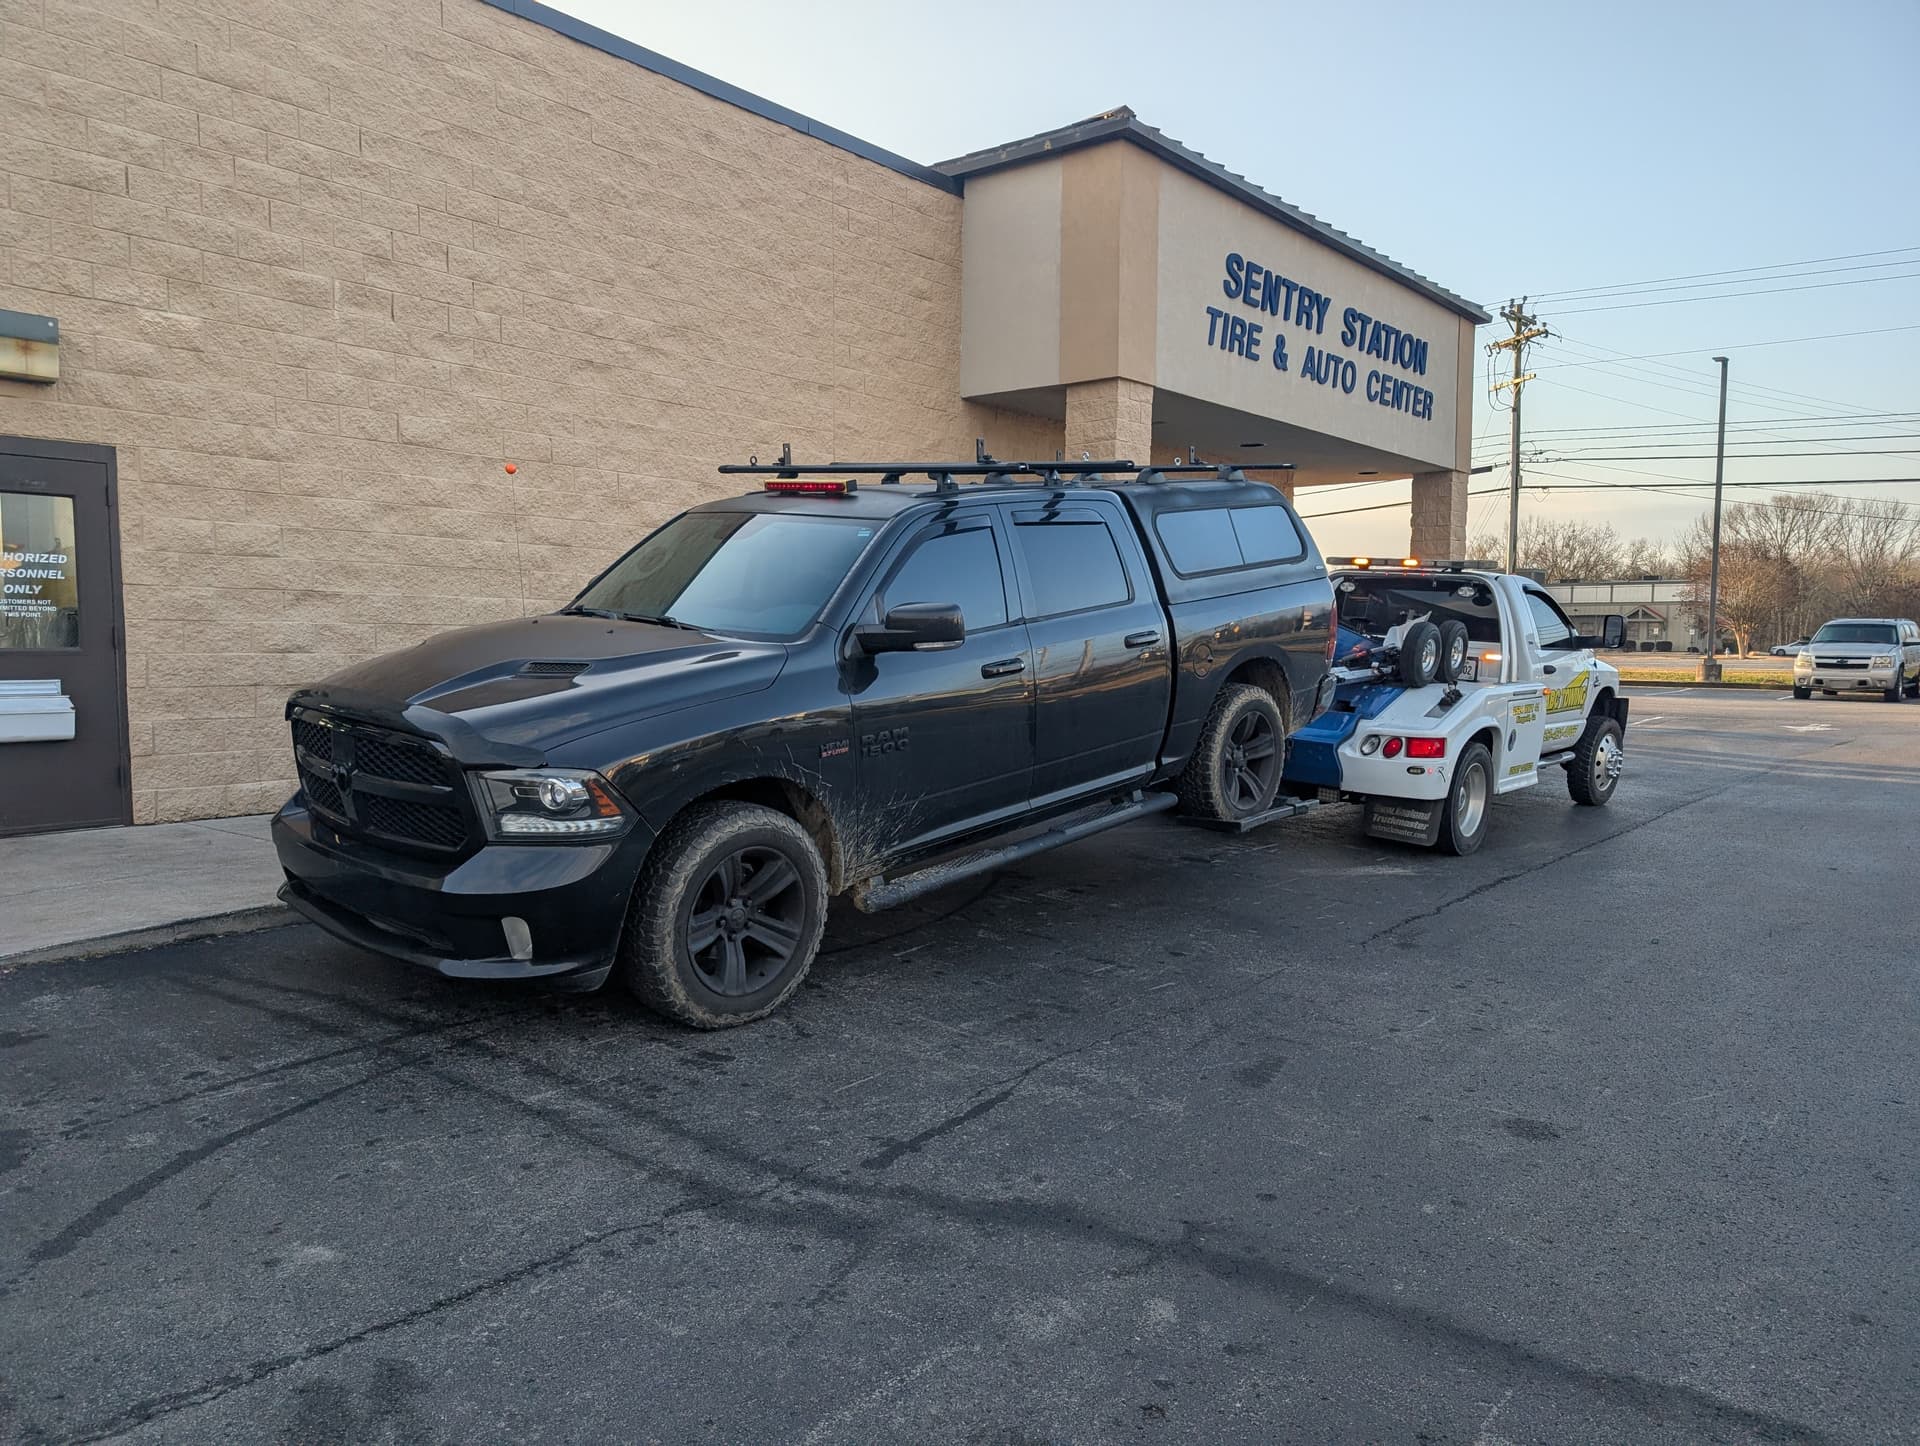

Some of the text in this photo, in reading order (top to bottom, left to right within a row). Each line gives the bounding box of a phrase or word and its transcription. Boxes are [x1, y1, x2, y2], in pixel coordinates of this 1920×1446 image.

[1223, 252, 1428, 375] SENTRY STATION
[1206, 306, 1434, 421] TIRE & AUTO CENTER
[0, 552, 68, 564] HORIZED
[4, 584, 42, 594] ONLY
[1562, 687, 1586, 708] TOWING
[820, 739, 849, 752] HEMI
[861, 726, 910, 746] RAM
[1372, 813, 1430, 831] Truckmaster
